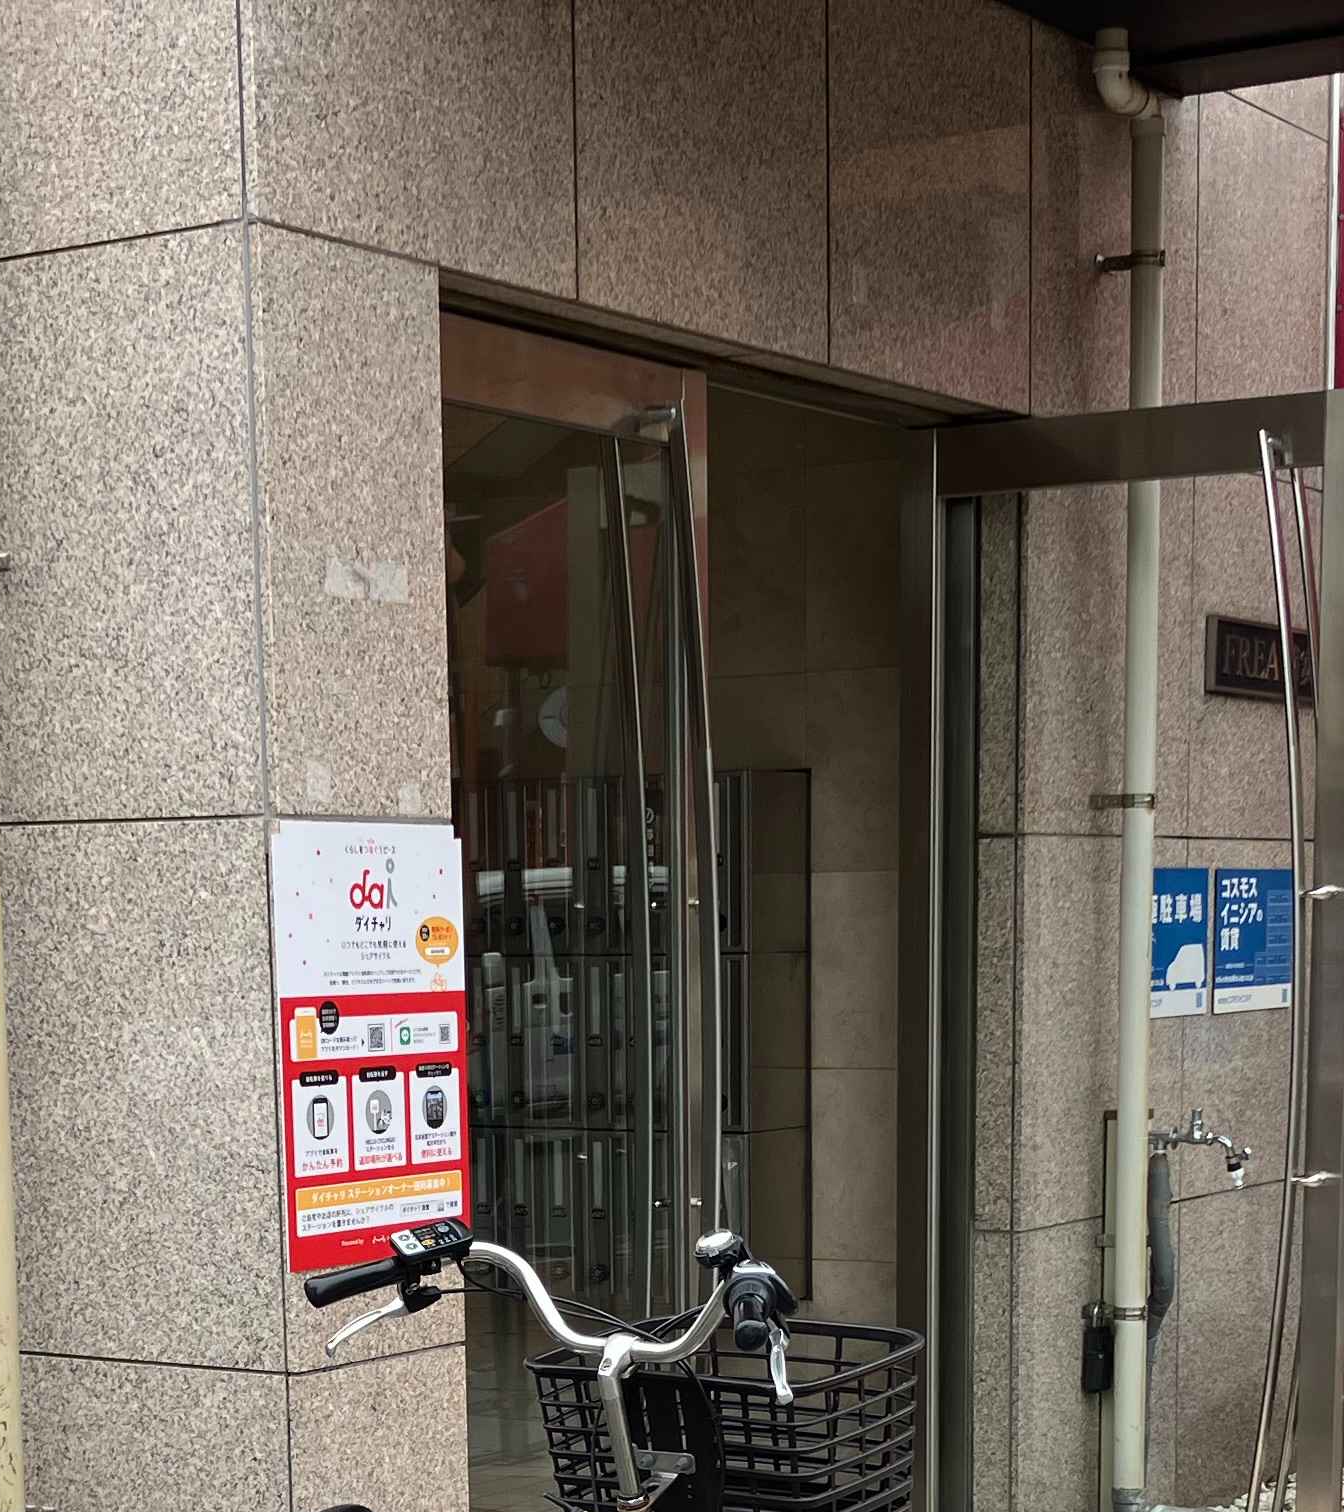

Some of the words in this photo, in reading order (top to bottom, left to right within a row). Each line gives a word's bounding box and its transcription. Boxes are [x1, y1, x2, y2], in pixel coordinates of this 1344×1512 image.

[1221, 877, 1258, 899] コスモス
[355, 916, 392, 932] ダイチャリ
[1220, 902, 1264, 926] イニシアの
